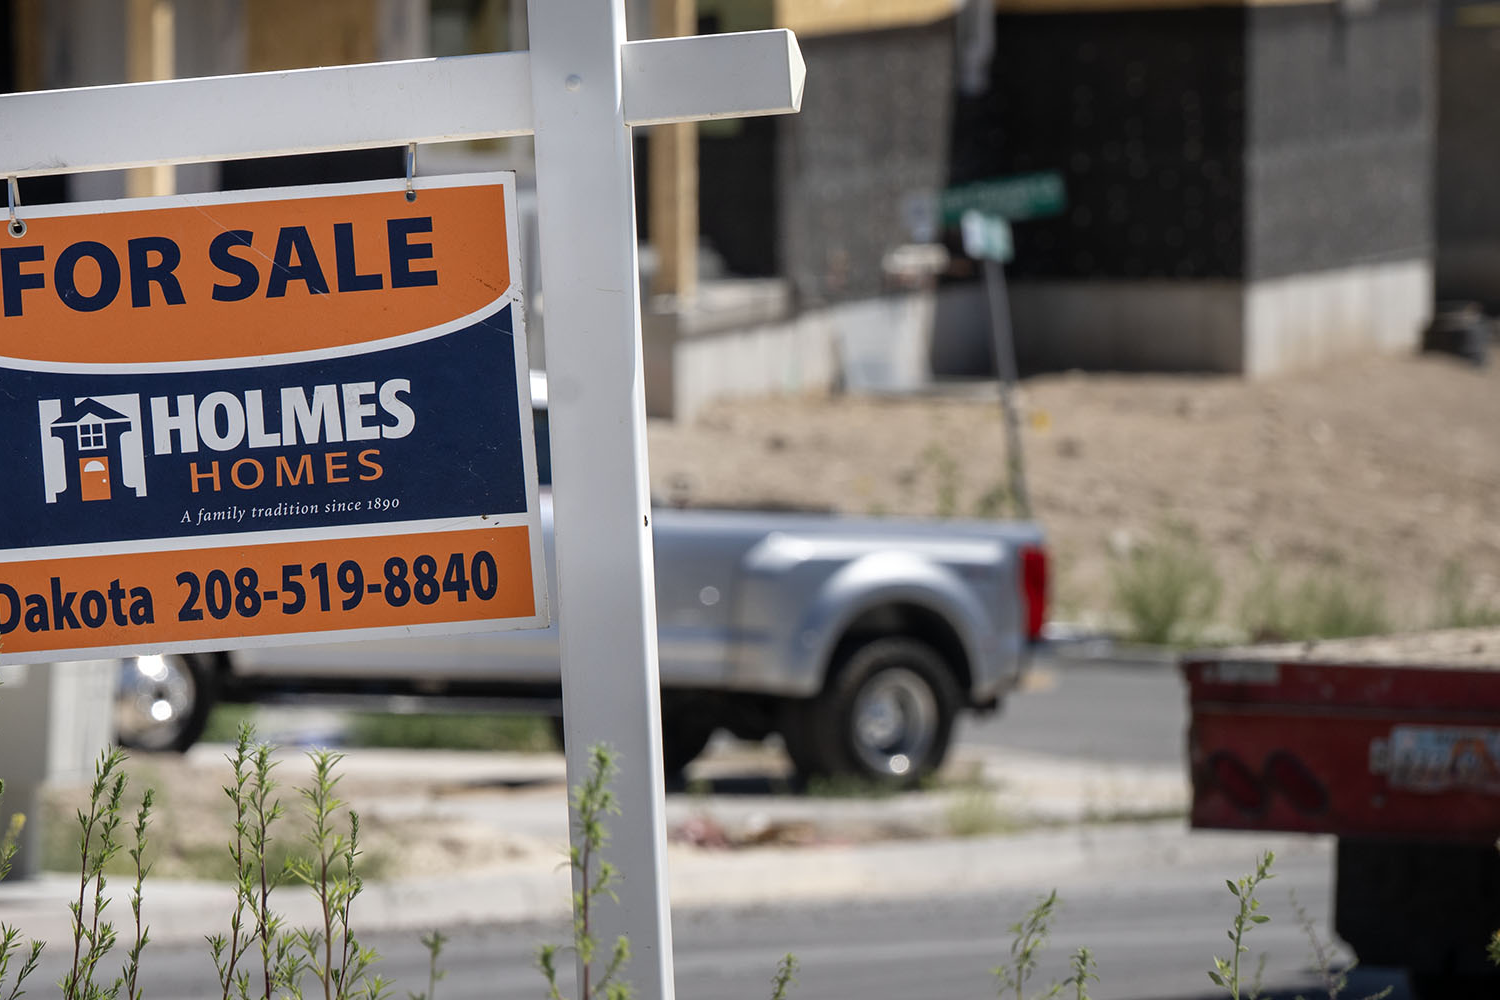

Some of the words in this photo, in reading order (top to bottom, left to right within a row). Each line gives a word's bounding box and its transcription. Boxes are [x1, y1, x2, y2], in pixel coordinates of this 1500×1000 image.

[0, 236, 186, 317] FOR
[208, 216, 438, 302] SALE
[150, 378, 415, 455] HOLMES
[190, 449, 384, 493] HOMES
[180, 510, 192, 524] A
[197, 505, 246, 525] family
[251, 501, 319, 518] tradition
[324, 499, 362, 514] since
[366, 497, 400, 512] 1890
[175, 551, 498, 622] 208-519-8840
